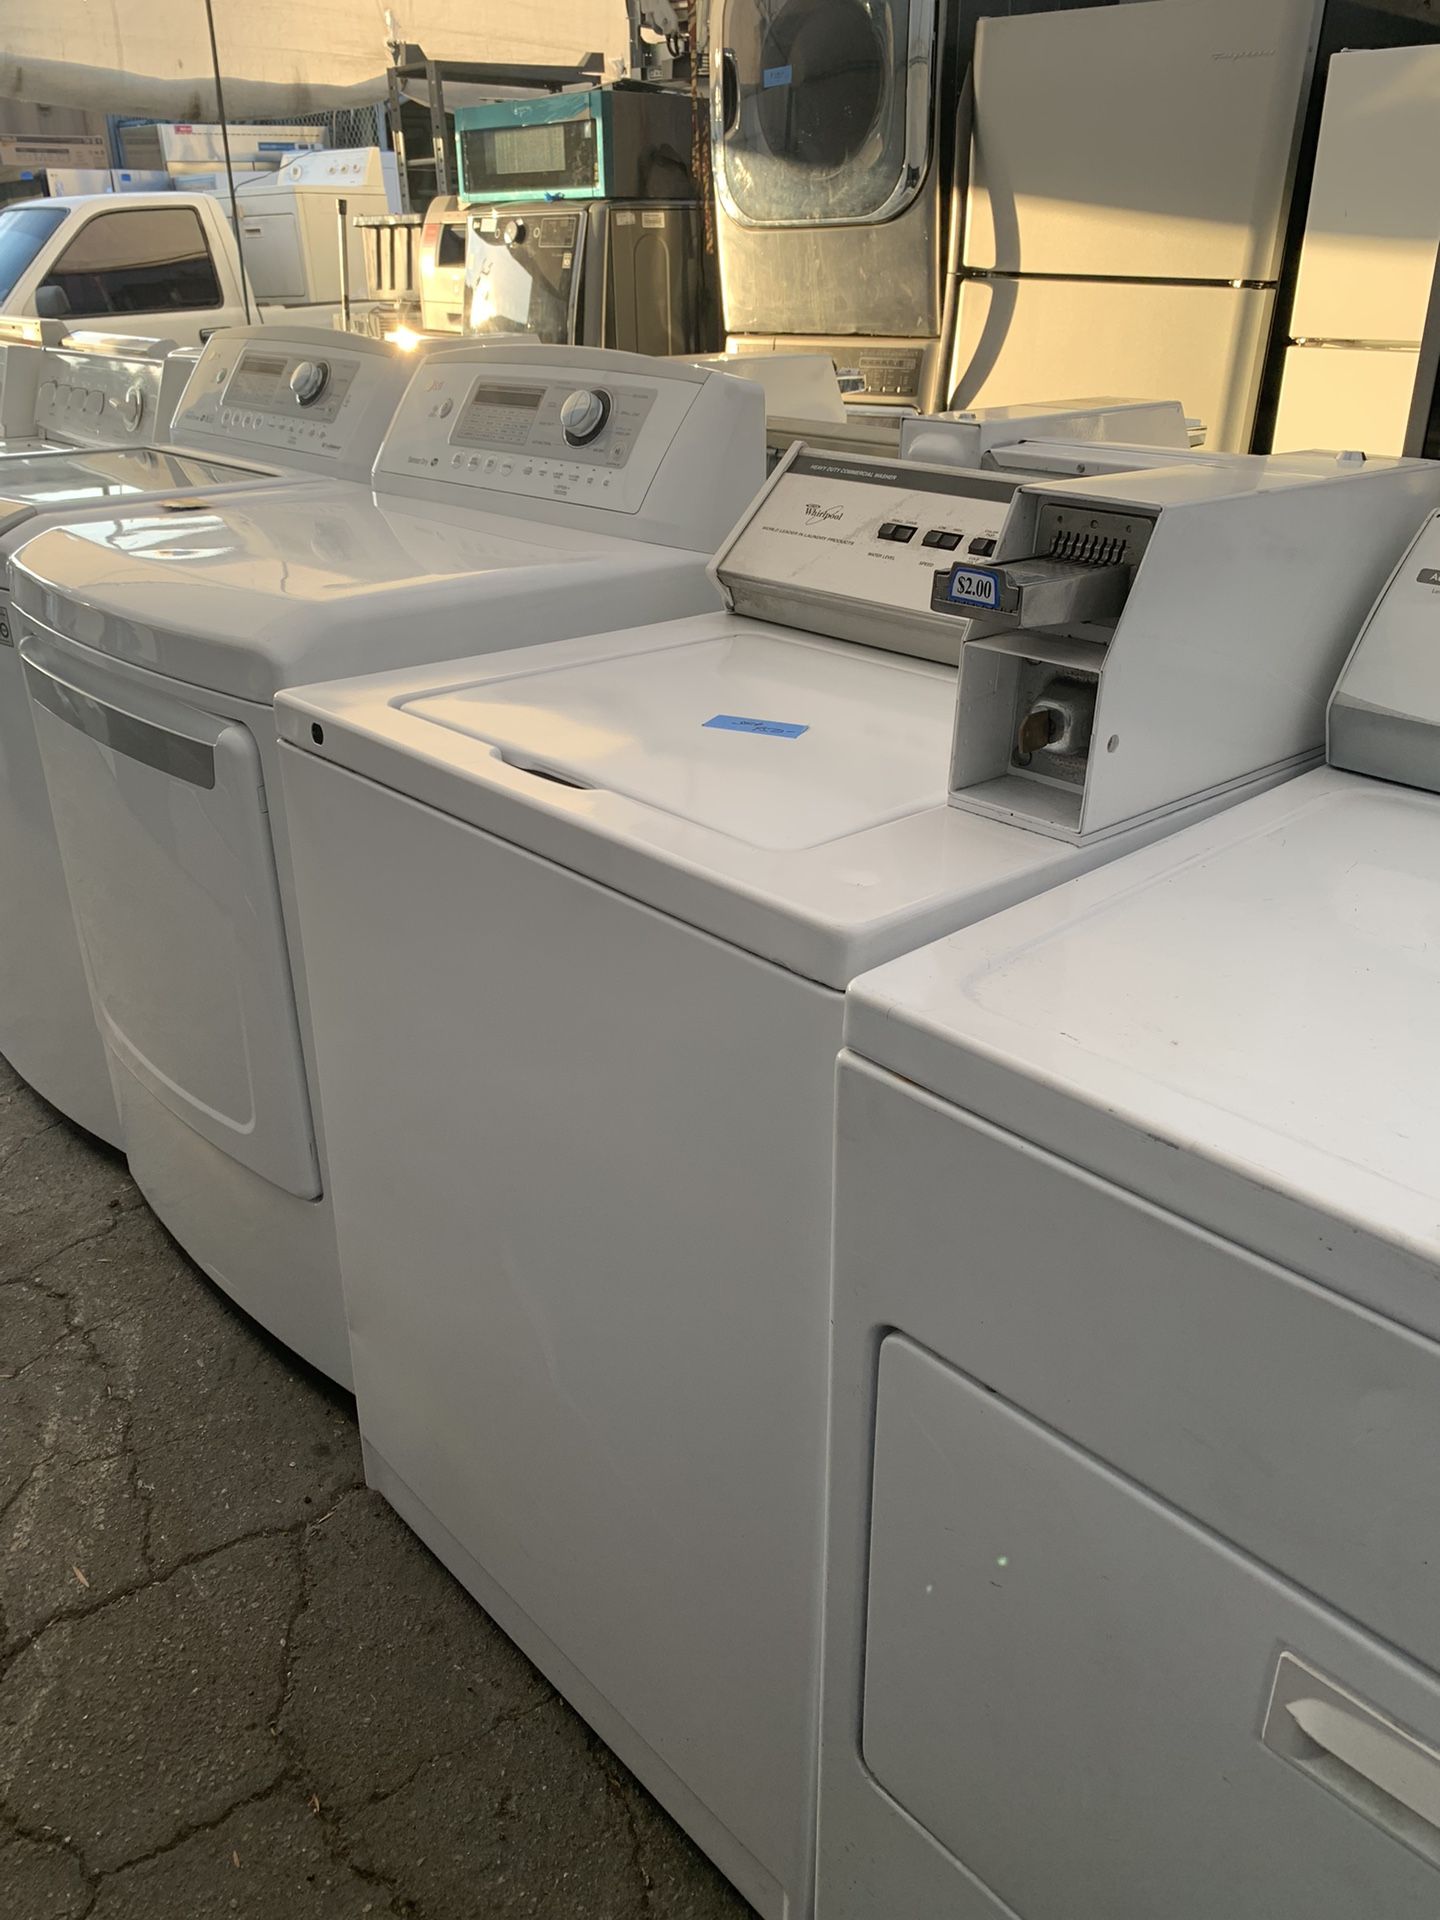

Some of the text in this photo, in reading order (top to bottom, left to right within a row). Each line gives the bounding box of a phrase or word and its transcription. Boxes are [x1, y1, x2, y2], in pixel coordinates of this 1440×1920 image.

[810, 464, 898, 481] HEAVY DUTY COMMERCIAL WASHER
[805, 507, 844, 521] Whirlpool
[762, 525, 780, 533] WORLD
[779, 528, 799, 536] LEADER
[804, 532, 827, 542] LAUNDRY
[827, 537, 855, 546] PRODUCTS
[867, 552, 896, 561] WATER LEVEL
[918, 560, 935, 568] SPEED
[957, 575, 992, 599] $2.00
